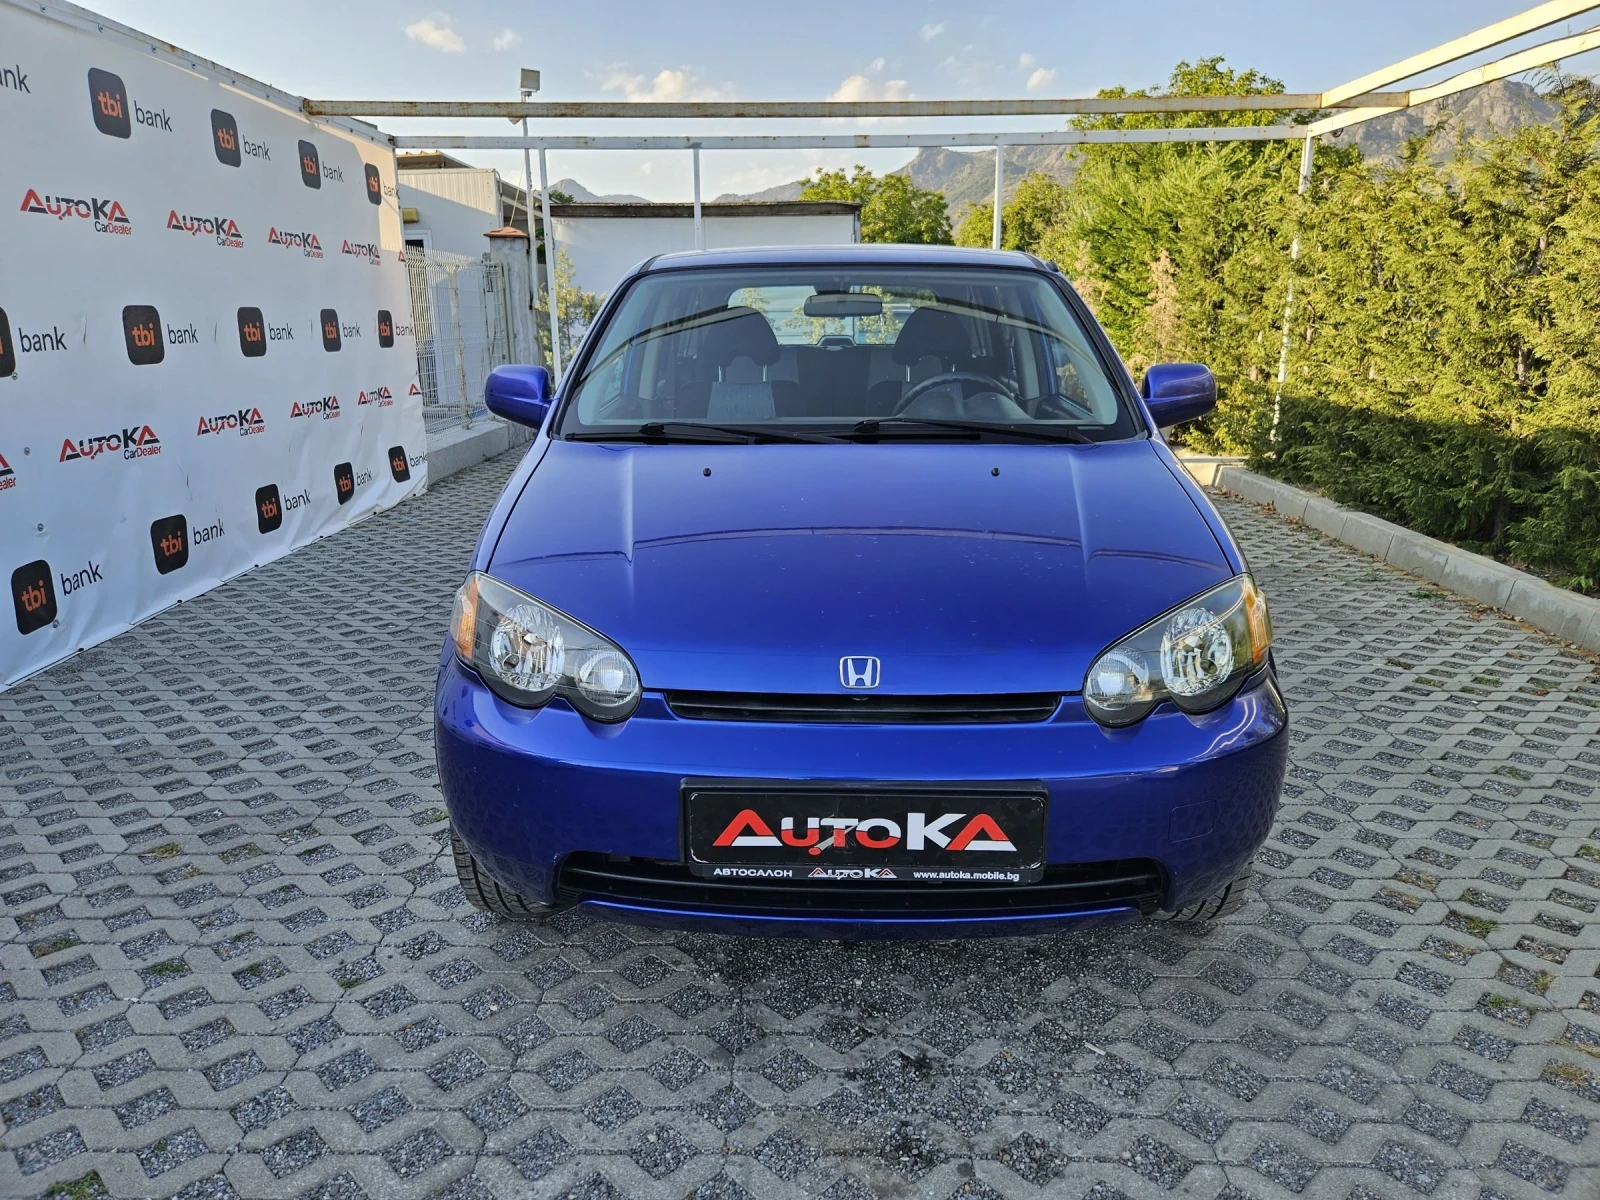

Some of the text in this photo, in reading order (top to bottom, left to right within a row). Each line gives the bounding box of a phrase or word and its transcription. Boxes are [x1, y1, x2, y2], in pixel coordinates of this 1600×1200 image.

[98, 91, 173, 132] tbi bank
[217, 129, 271, 161] tbi bank
[303, 156, 344, 182] tbi bank
[369, 175, 379, 193] tbi
[94, 220, 132, 236] CarDealer
[18, 326, 67, 353] bank
[132, 323, 199, 347] tbi bank
[243, 321, 294, 342] tbi bank
[324, 321, 361, 339] tbi bank
[380, 321, 415, 337] tbi bank
[123, 445, 162, 460] CarDealer
[392, 456, 406, 472] tbi
[339, 468, 373, 493] tbi bank
[261, 489, 312, 519] tbi bank
[160, 518, 225, 556] tbi bank
[21, 560, 103, 612] tbi bank
[713, 867, 793, 878] АВТОСАЛОН
[913, 870, 1020, 882] www.autoka.mobile.bg
